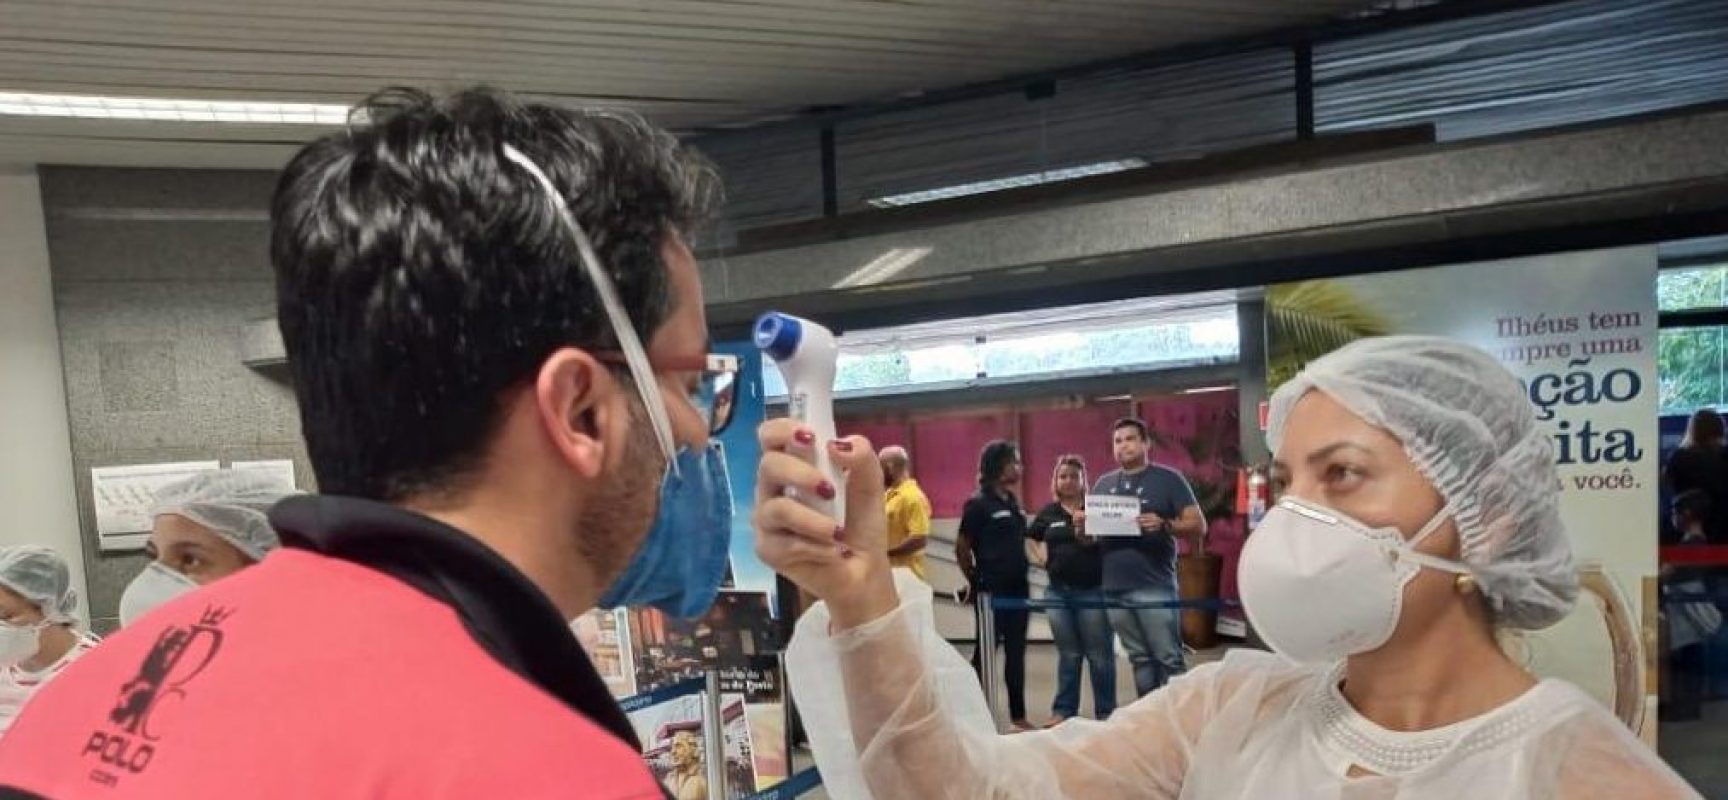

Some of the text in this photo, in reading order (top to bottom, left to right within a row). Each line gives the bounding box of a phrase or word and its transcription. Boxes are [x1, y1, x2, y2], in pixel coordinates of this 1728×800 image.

[1496, 311, 1641, 338] Ilhéus tem
[1502, 337, 1642, 366] mpre uma
[1523, 358, 1642, 421] ção
[1550, 420, 1643, 464] ita
[1574, 467, 1642, 490] você.
[81, 730, 155, 773] POLO
